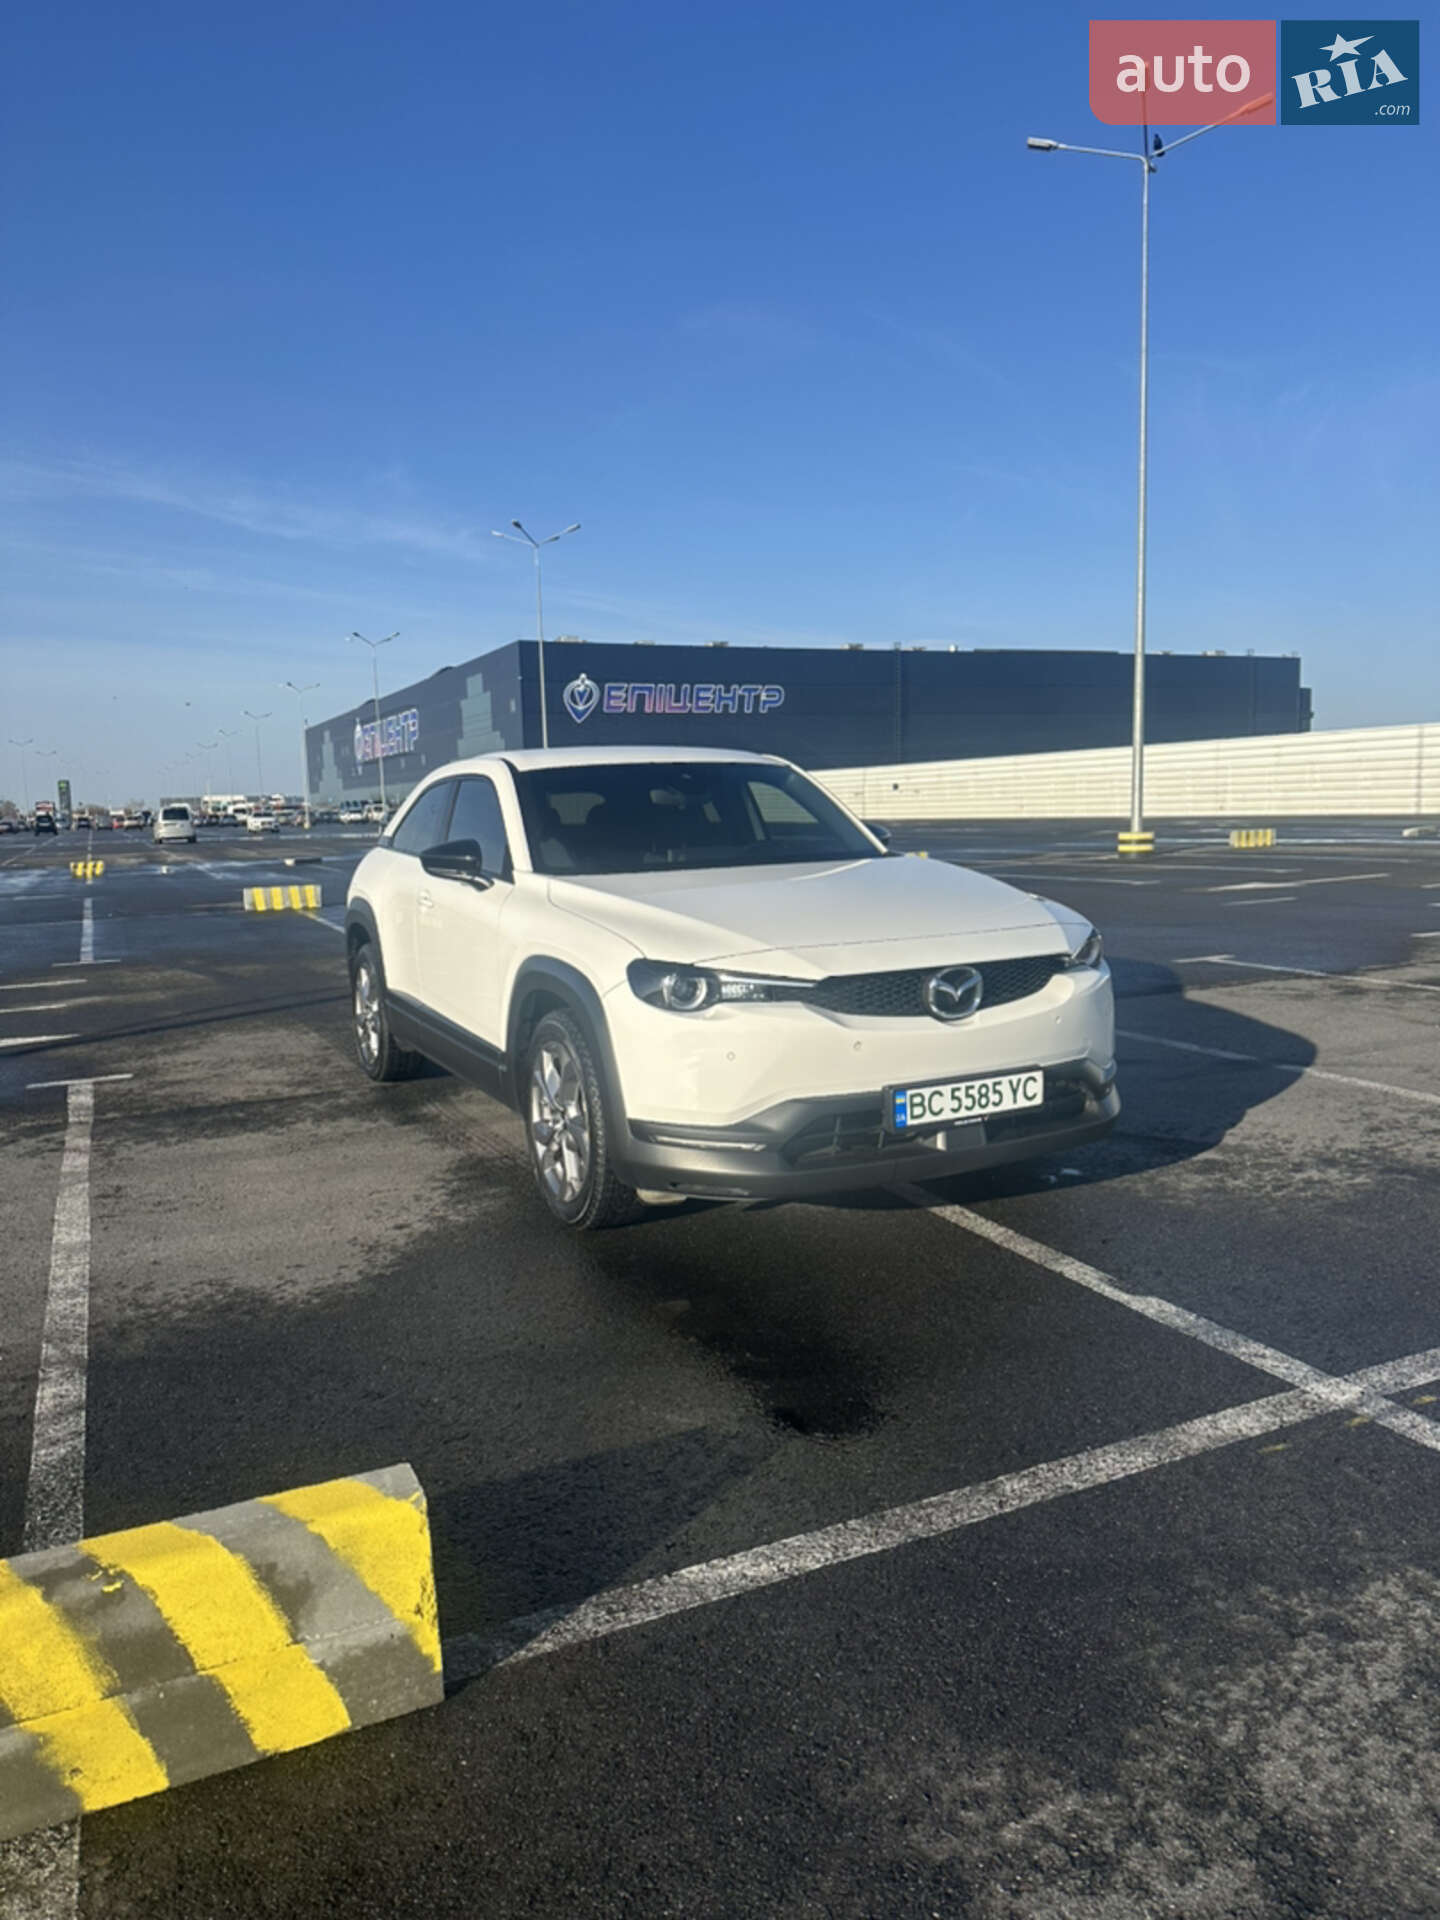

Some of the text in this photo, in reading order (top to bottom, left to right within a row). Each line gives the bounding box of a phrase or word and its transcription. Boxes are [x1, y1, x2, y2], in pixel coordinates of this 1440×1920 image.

[602, 682, 785, 714] ЕПІЦЕНТР
[909, 1076, 1038, 1120] BC 5585 YC
